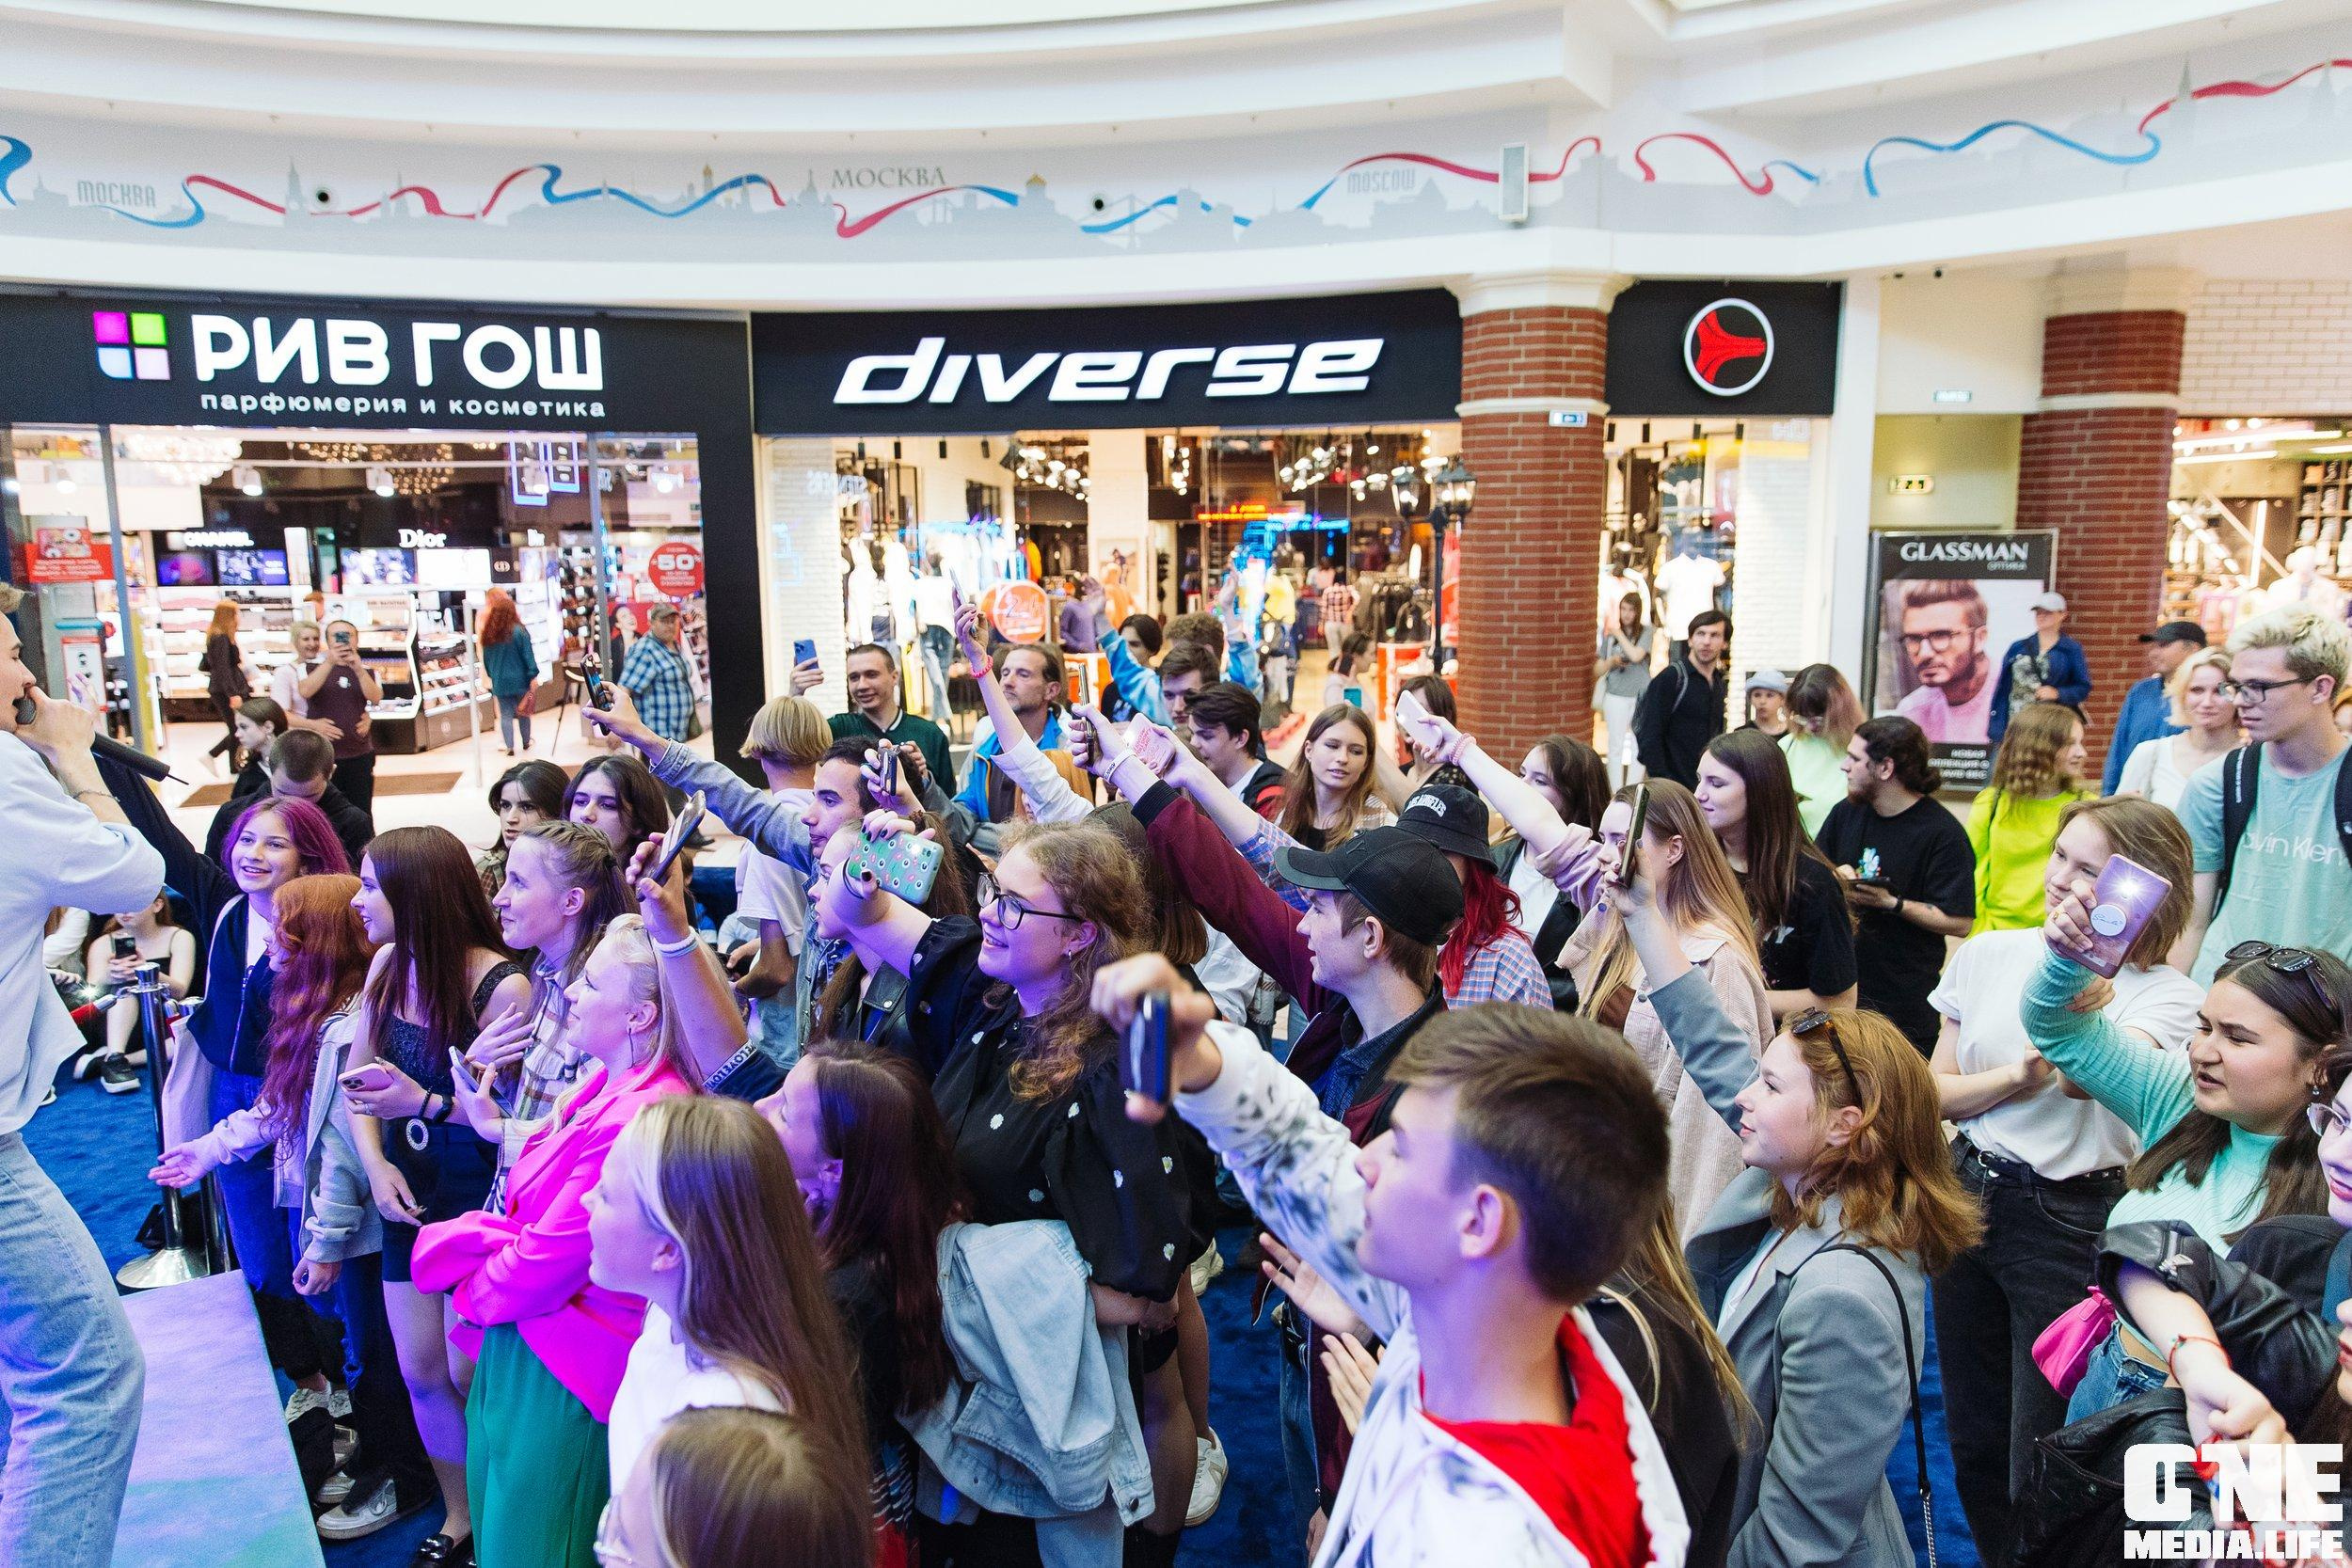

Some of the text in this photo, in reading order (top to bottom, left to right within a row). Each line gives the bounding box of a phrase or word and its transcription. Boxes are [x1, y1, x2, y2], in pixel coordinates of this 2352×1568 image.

[192, 314, 604, 390] РИВ ГОШ
[834, 337, 1384, 404] diverse
[201, 392, 606, 419] парфюмерия и косметика
[398, 529, 447, 548] Dior
[1900, 542, 2029, 562] GLASSMAN
